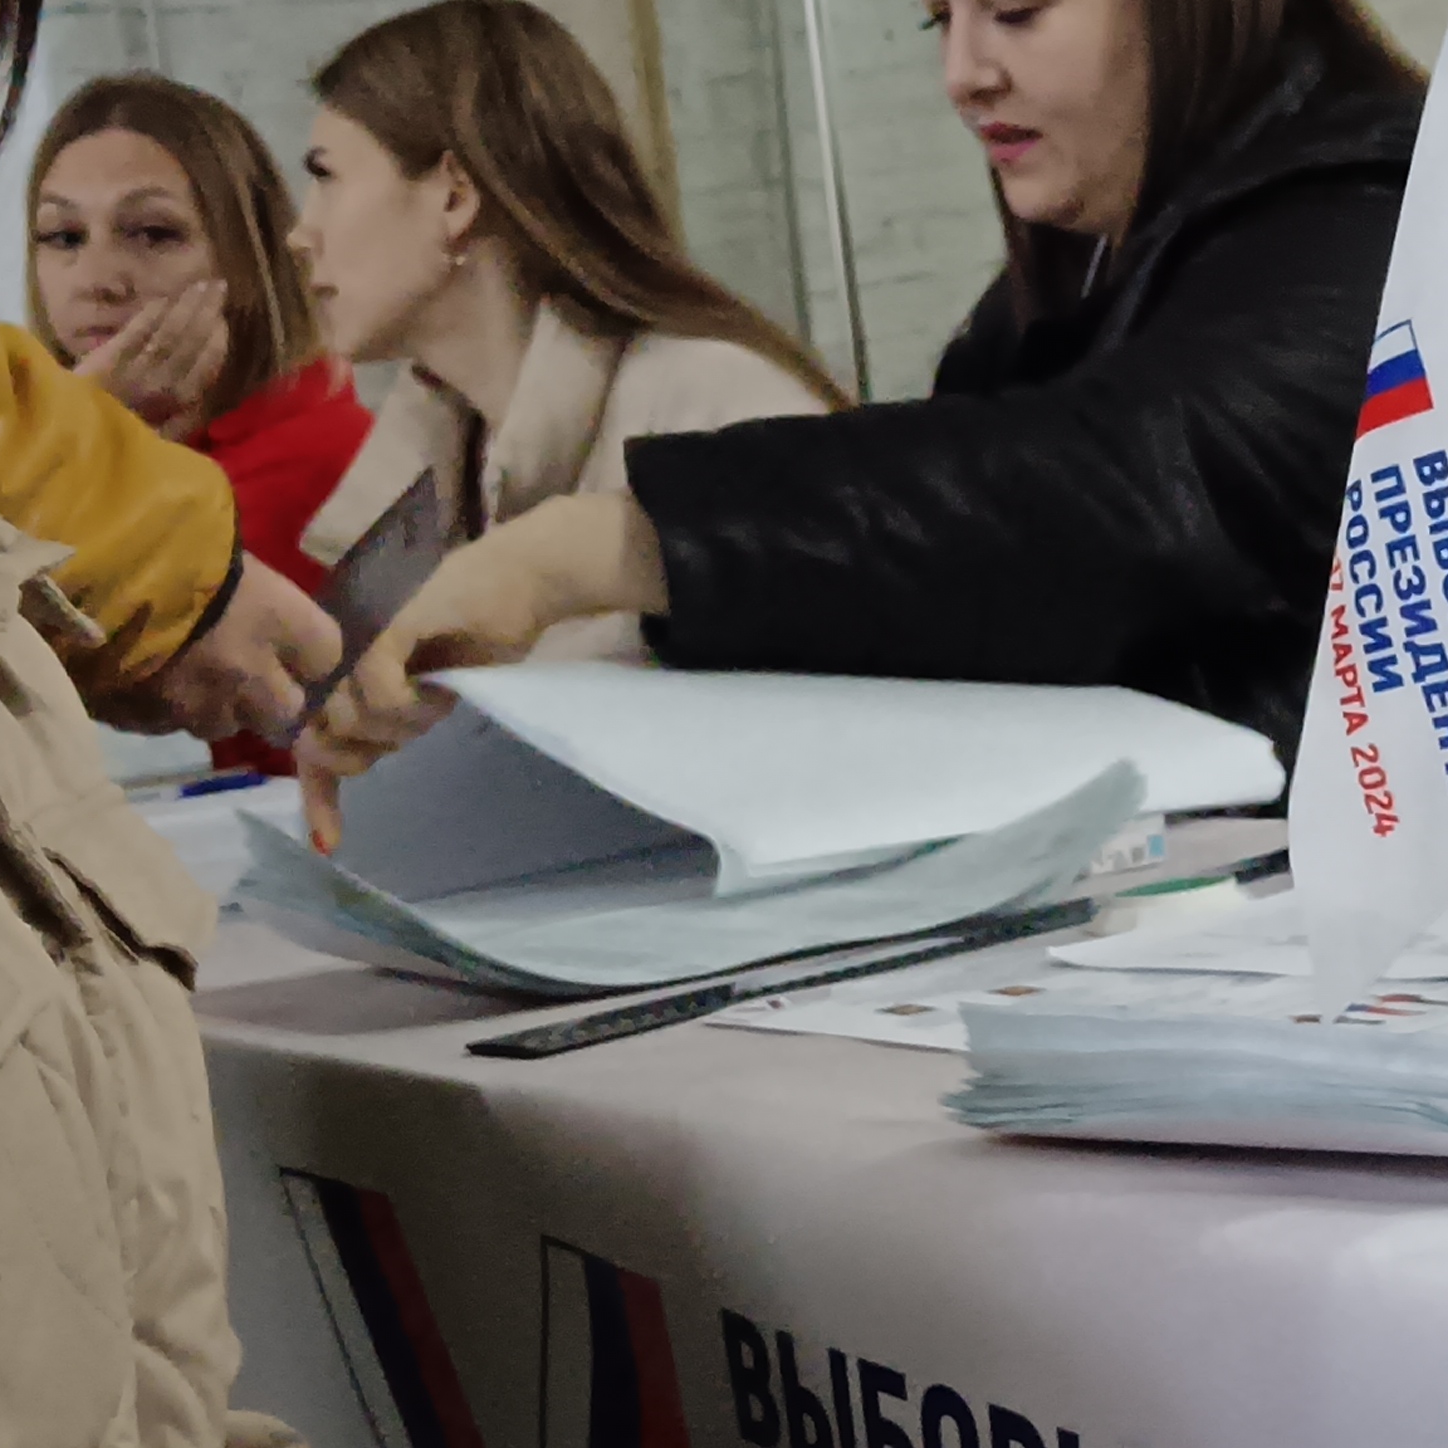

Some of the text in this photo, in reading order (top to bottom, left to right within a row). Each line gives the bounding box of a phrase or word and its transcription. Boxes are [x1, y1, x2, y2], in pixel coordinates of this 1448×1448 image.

[1345, 478, 1404, 694] РОССИИ
[1329, 604, 1371, 737] МАРТА
[1350, 742, 1400, 838] 2024
